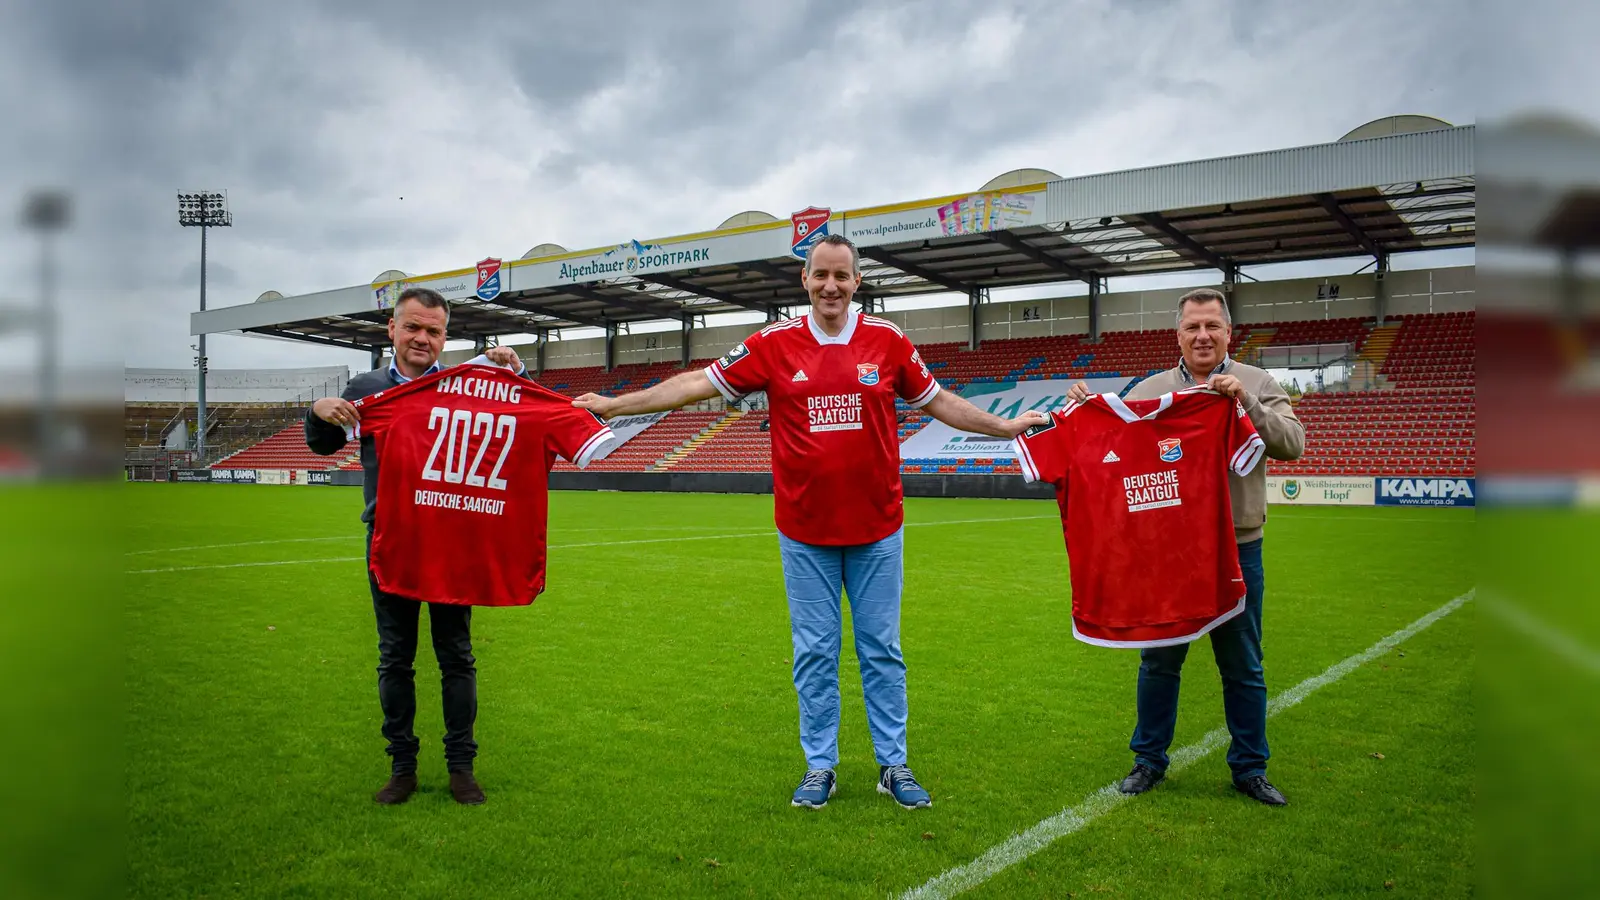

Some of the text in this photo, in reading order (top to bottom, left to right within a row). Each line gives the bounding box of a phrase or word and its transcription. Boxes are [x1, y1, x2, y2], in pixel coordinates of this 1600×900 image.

[851, 217, 937, 237] www.alpenbauer.de
[558, 247, 710, 281] Alpenbauer SPORTPARK
[437, 375, 522, 404] HACHING
[807, 392, 862, 410] DEUTSCHE
[808, 407, 863, 425] SAATGUT
[421, 406, 517, 491] 2022
[942, 443, 1000, 451] Mobilien
[211, 469, 232, 479] KAMPA
[234, 470, 256, 480] KAMPA
[1123, 469, 1179, 490] DEUTSCHE
[1304, 480, 1372, 489] Weißbierbrauerei
[1380, 479, 1474, 498] KAMPA
[414, 489, 506, 516] DEUTSCHE SAATGUT
[1126, 483, 1179, 505] SAATGUT
[1323, 489, 1351, 502] Hopf
[1399, 498, 1455, 506] www.kampa.de
